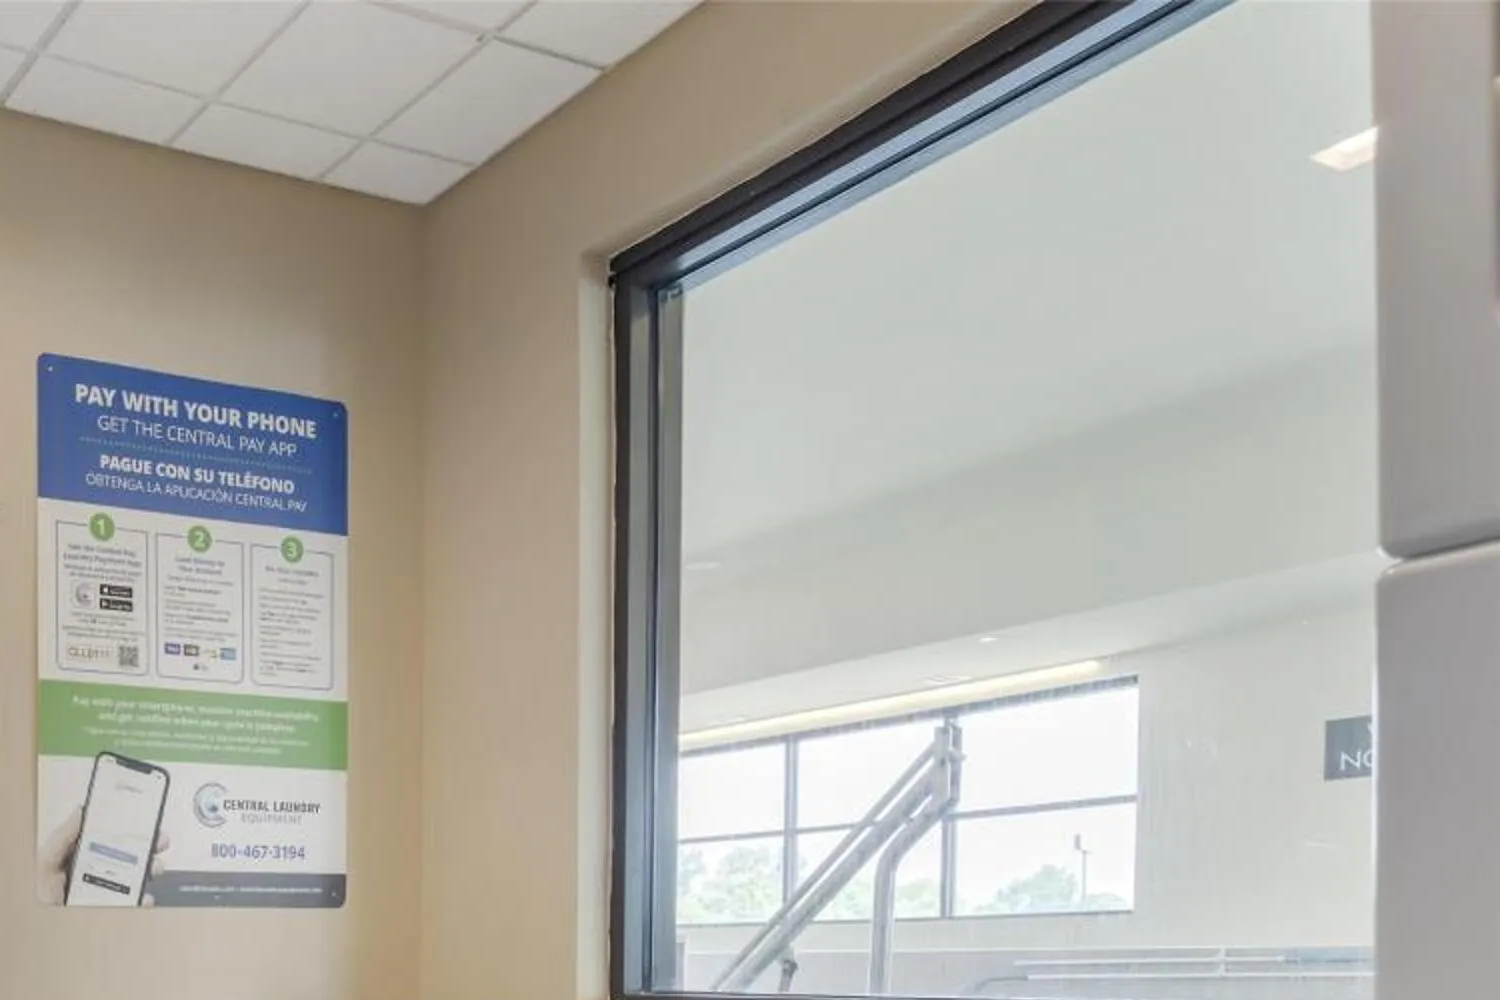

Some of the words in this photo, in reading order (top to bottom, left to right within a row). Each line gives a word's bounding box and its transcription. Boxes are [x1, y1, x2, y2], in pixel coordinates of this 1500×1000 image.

[75, 383, 117, 408] PAY
[121, 390, 179, 418] WITH
[183, 401, 242, 429] YOUR
[247, 411, 317, 439] PHONE
[97, 415, 129, 433] GET
[131, 419, 165, 439] THE
[167, 425, 235, 450] CENTRAL
[239, 436, 266, 453] PAY
[267, 441, 297, 457] APP
[100, 454, 153, 475] PAGUE
[156, 462, 190, 481] CON
[193, 467, 215, 483] SU
[218, 471, 295, 495] TELÉFONO
[85, 473, 144, 491] OBTENGA
[147, 481, 162, 494] LA
[235, 493, 285, 511] CENTRAL
[286, 499, 308, 513] PAY
[97, 518, 106, 535] 1
[194, 530, 206, 548] 2
[286, 541, 298, 558] 3
[223, 799, 269, 813] CENTRAL
[273, 800, 321, 814] LAUNDRY
[211, 843, 306, 860] 800-467-3194
